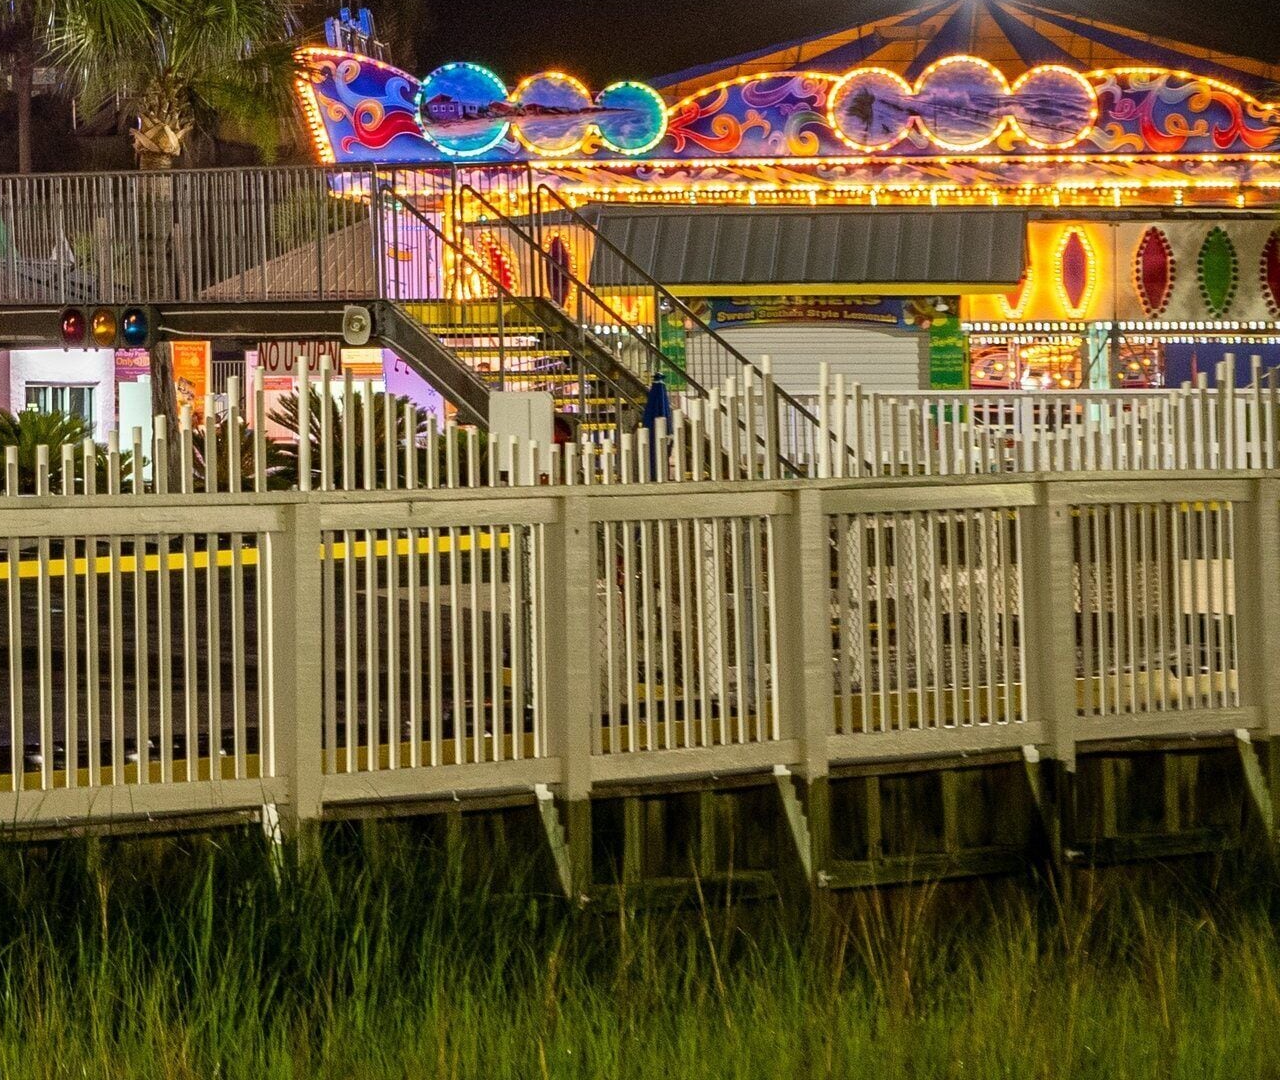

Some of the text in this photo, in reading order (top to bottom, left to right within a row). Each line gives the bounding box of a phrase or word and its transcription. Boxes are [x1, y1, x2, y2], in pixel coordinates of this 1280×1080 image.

[716, 311, 755, 321] Sweet
[806, 309, 839, 319] Style
[258, 340, 338, 371] NO U-TURN
